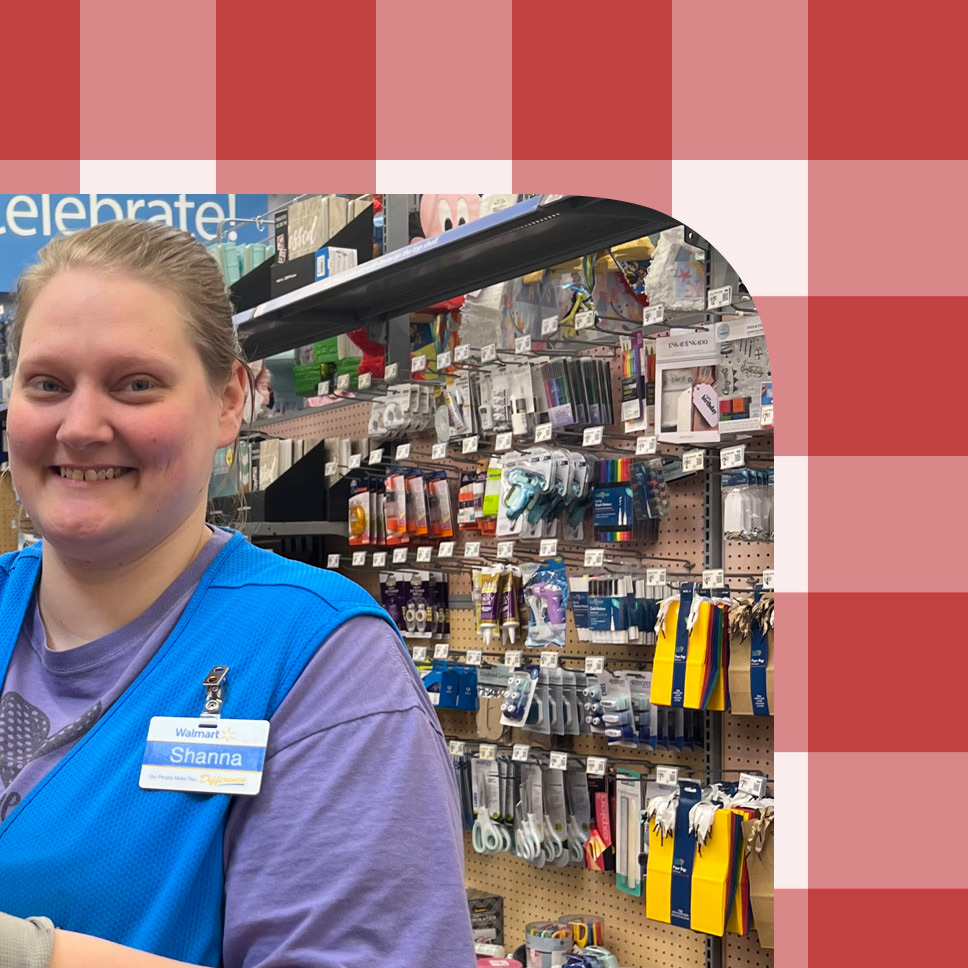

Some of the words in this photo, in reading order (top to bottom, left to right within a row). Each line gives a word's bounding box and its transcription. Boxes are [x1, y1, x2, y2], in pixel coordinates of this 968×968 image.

[175, 728, 220, 739] Walmart
[170, 747, 242, 766] Shanna
[200, 774, 246, 786] Difference
